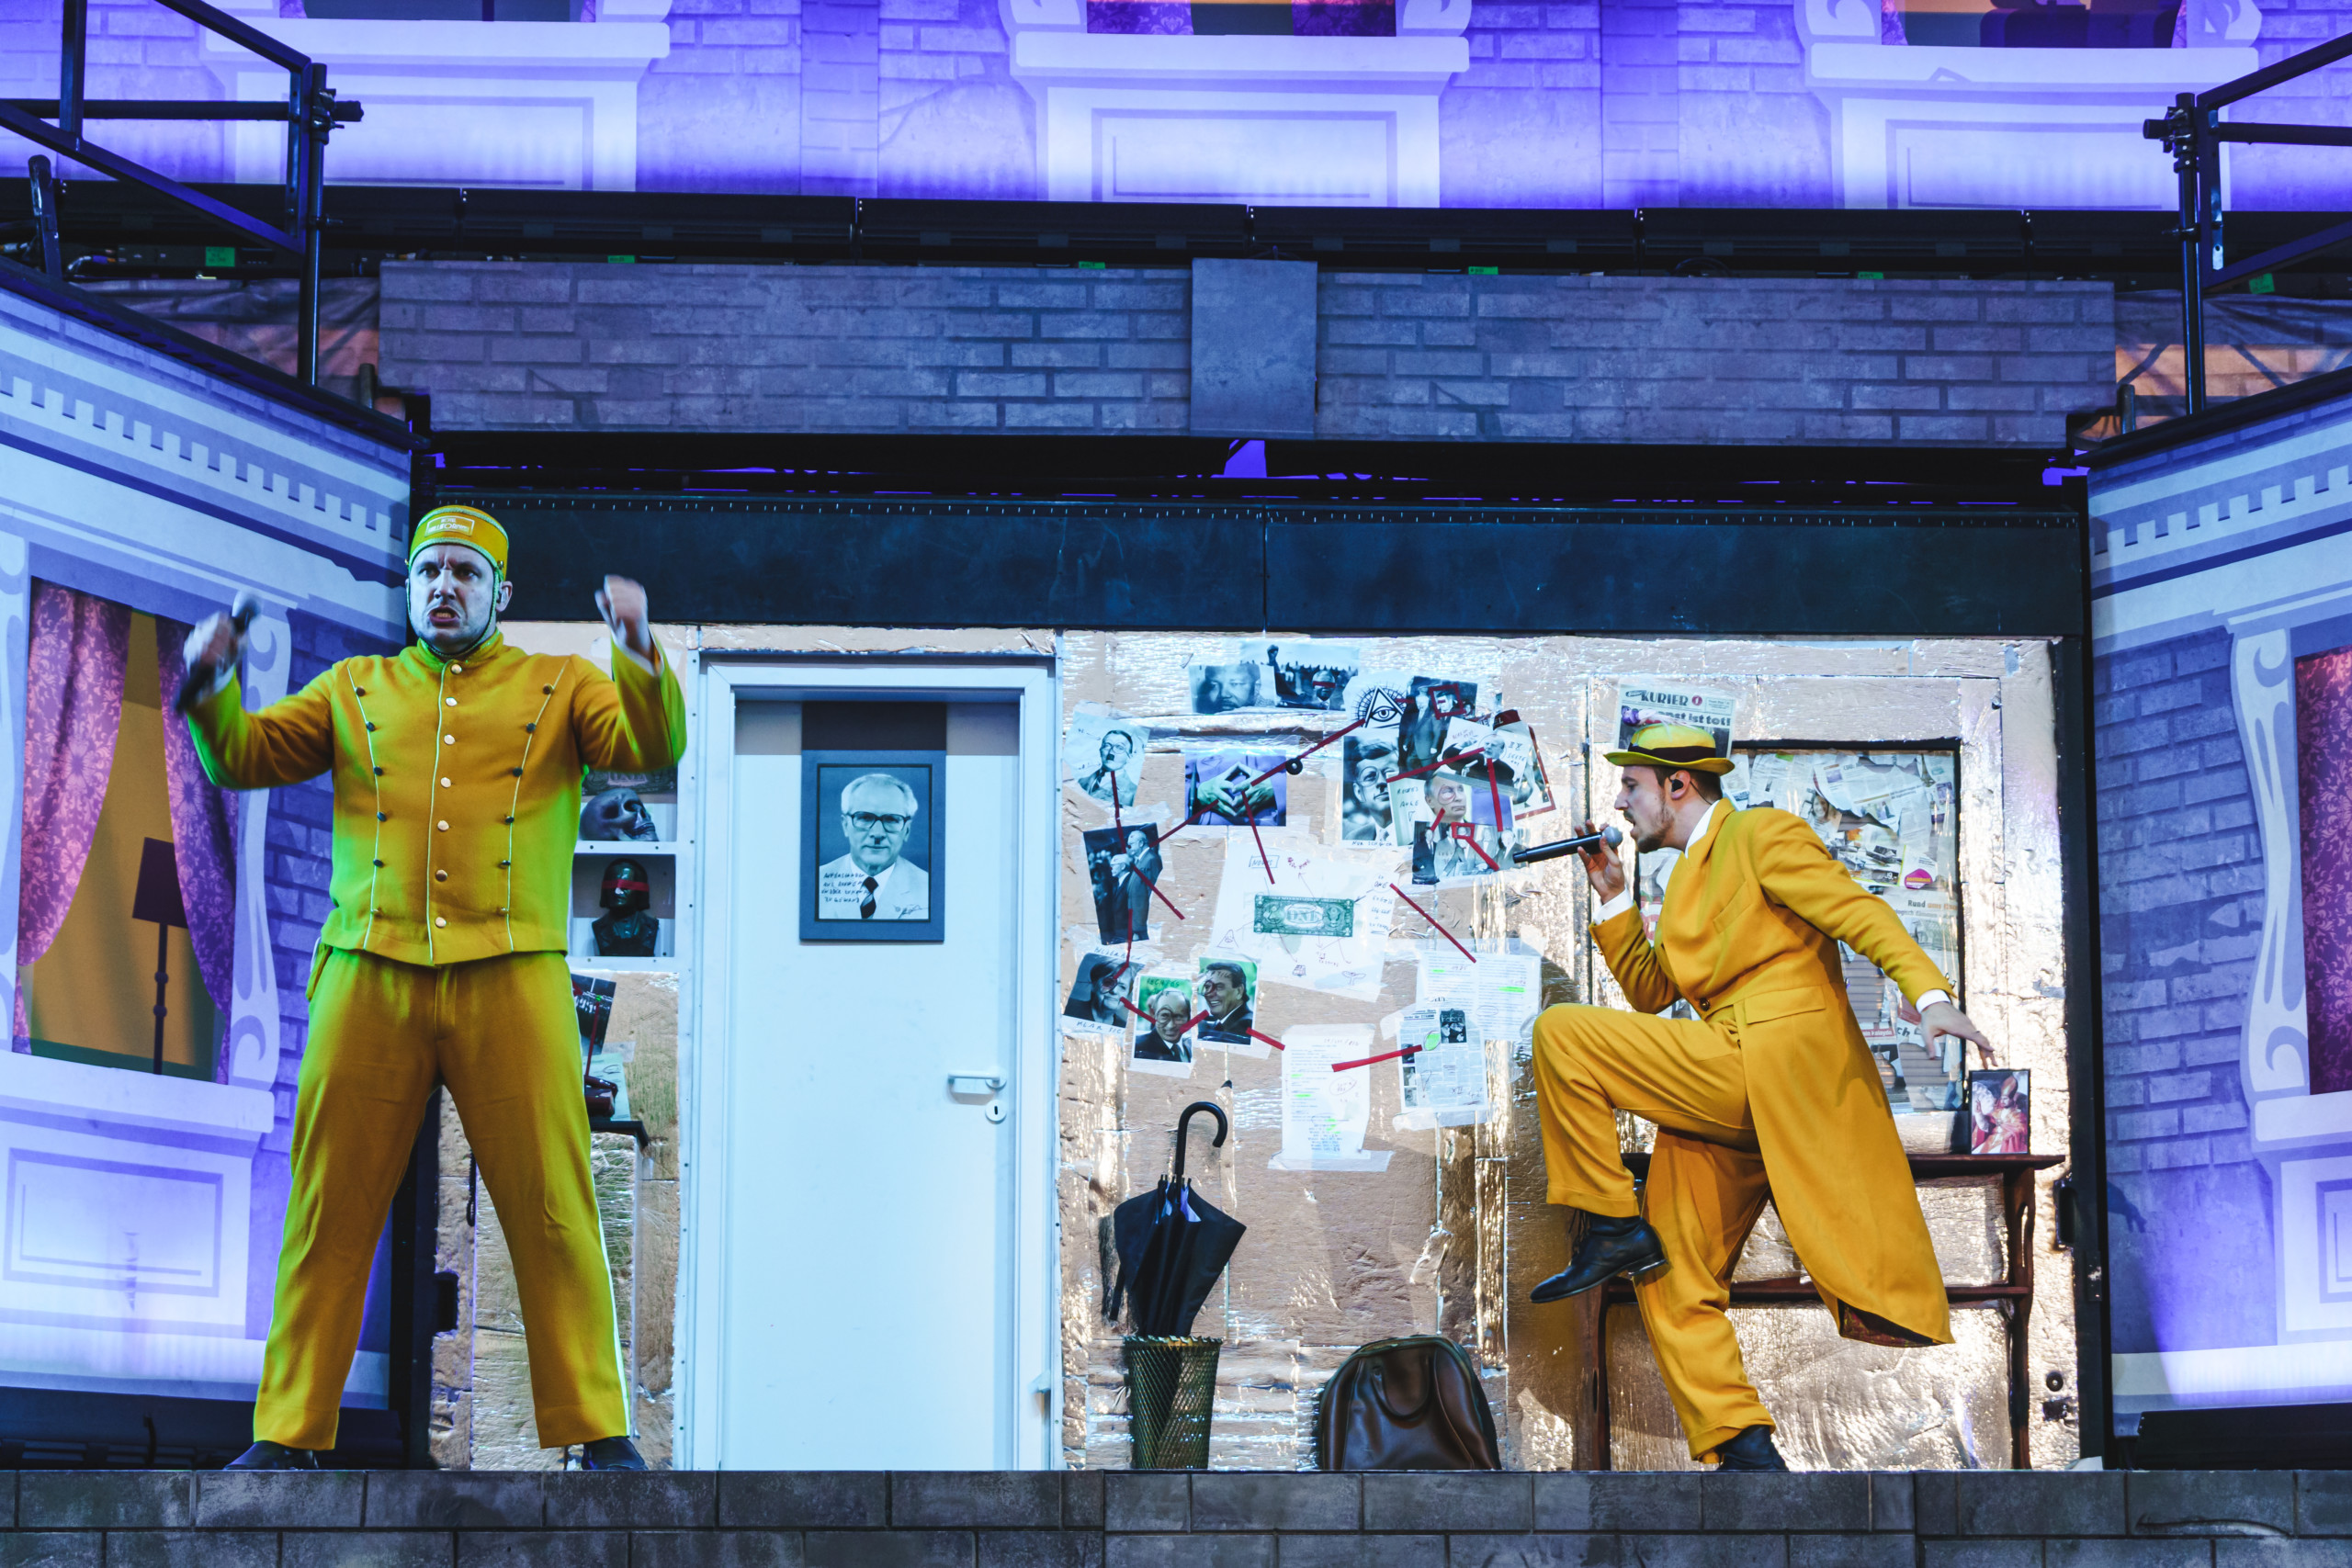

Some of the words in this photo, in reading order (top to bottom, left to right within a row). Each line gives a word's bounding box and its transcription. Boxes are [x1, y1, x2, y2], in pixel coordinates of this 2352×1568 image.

[1641, 692, 1689, 706] KURIER
[1689, 713, 1704, 724] ist
[1706, 716, 1731, 727] tot!
[1907, 899, 1926, 908] Rund
